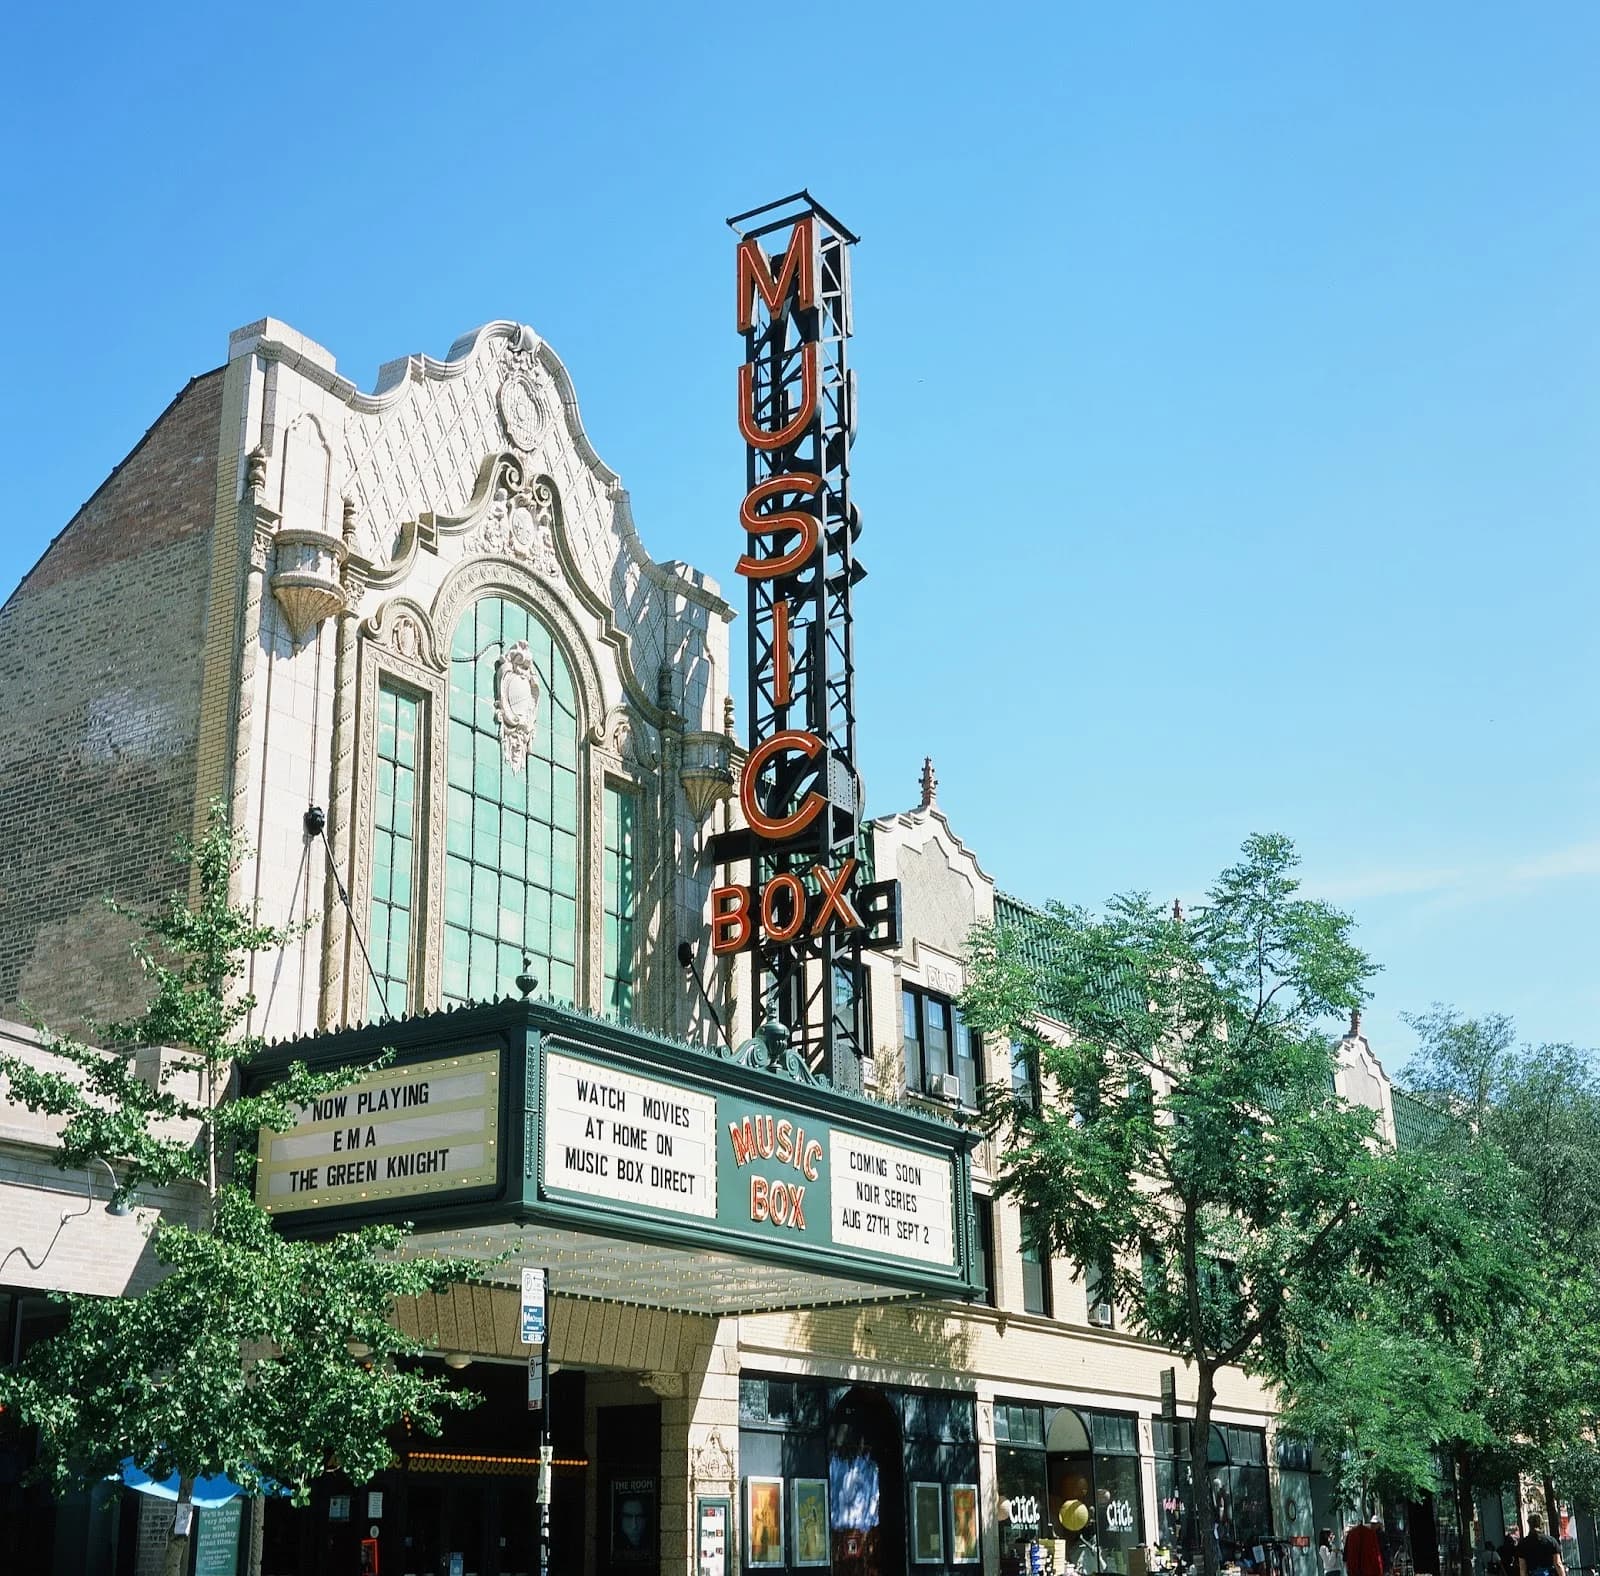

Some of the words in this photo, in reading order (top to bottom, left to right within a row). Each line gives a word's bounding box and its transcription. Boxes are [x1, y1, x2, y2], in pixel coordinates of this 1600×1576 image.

[735, 217, 828, 839] MUSIC
[711, 858, 864, 956] BOX
[312, 1096, 347, 1121] NOW
[357, 1082, 429, 1115] PLAYING
[577, 1079, 625, 1112] WATCH
[643, 1097, 689, 1128] MOVIES
[585, 1117, 604, 1140] AT
[613, 1123, 647, 1150] HOME
[657, 1134, 673, 1157] ON
[728, 1114, 822, 1182] MUSIC
[290, 1168, 318, 1192] THE
[327, 1159, 377, 1187] GREEN
[387, 1149, 449, 1179] KNIGHT
[565, 1147, 608, 1176] MUSIC
[618, 1158, 644, 1184] BOX
[651, 1166, 695, 1195] DIRECT
[850, 1152, 887, 1177] COMING
[896, 1164, 921, 1186] SOON
[750, 1174, 806, 1231] BOX
[857, 1182, 879, 1203] NOIR
[885, 1190, 917, 1213] SERIES
[842, 1208, 860, 1230] AUG
[866, 1213, 890, 1237] 27TH
[897, 1221, 919, 1243] SEPT
[924, 1226, 930, 1244] 2
[615, 1480, 629, 1490] THE
[630, 1479, 653, 1489] ROOM
